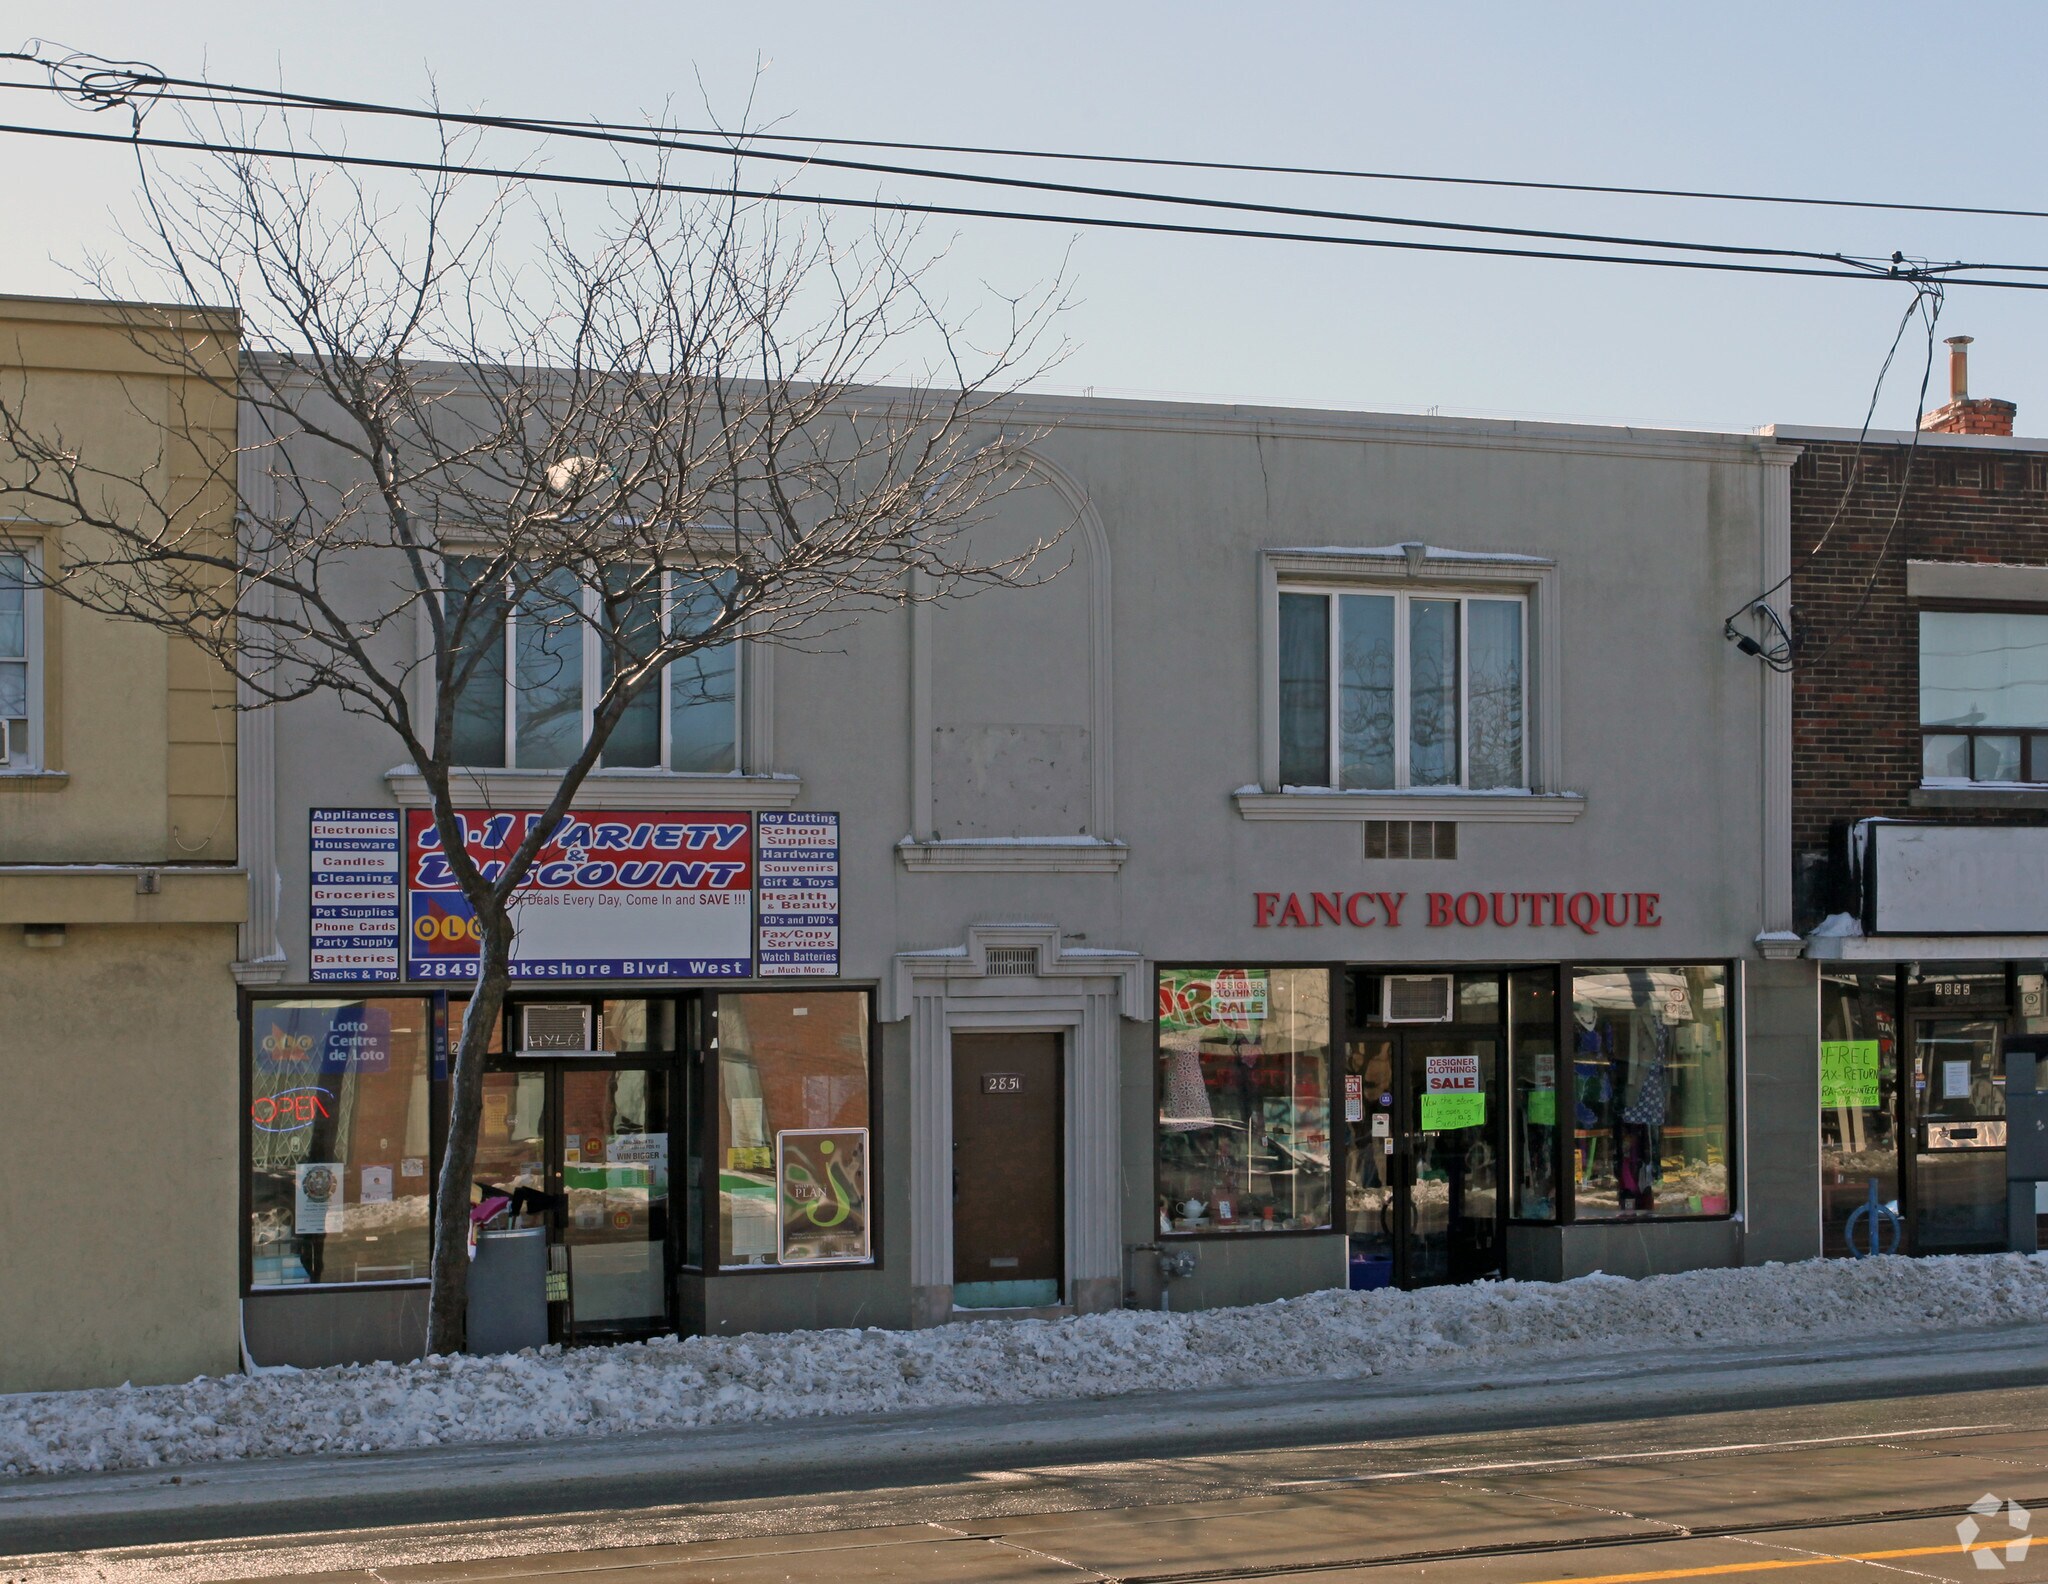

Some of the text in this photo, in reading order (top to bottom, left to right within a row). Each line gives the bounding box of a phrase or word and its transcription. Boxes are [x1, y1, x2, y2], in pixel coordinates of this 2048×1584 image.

[314, 810, 394, 820] Appliances
[760, 813, 836, 824] Key Cutting
[314, 826, 395, 834] Electronics
[525, 813, 748, 850] VARIETY
[761, 827, 826, 836] School
[315, 840, 395, 849] Houseware
[768, 837, 835, 846] Supplies
[567, 849, 586, 863] &
[762, 850, 834, 858] Hardware
[323, 858, 384, 866] Candles
[764, 864, 834, 872] Souvenirs
[318, 874, 393, 884] Cleaning
[763, 878, 834, 887] Gift & Toys
[315, 891, 395, 899] Groceries
[762, 892, 826, 900] Health
[528, 894, 559, 905] Deals
[563, 894, 594, 906] Every
[599, 894, 622, 907] Day,
[626, 894, 657, 905] Come
[662, 894, 671, 905] In
[676, 894, 695, 905] and
[699, 894, 730, 905] SAVE
[734, 894, 745, 905] !!!
[781, 901, 836, 910] Beauty
[316, 908, 394, 917] Pet Supplies
[1254, 892, 1662, 935] FANCY BOUTIQUE
[764, 916, 833, 924] CD's and DVD's
[315, 923, 396, 931] Phone Cards
[762, 930, 831, 939] Fax/Copy
[316, 938, 393, 948] Party Supply
[768, 939, 835, 948] Services
[761, 952, 836, 961] Watch Batteries
[420, 962, 742, 976] 2849 akeshore Blvd. West
[314, 970, 396, 980] Snacks & Pop
[1935, 984, 1970, 994] 2855
[1216, 1002, 1263, 1013] SALE
[330, 1021, 368, 1031] Lotto
[265, 1037, 310, 1049] OLG
[329, 1035, 377, 1046] Centre
[329, 1049, 384, 1060] de Loto
[1430, 1058, 1474, 1066] DESIGNER
[1428, 1066, 1477, 1074] CLOTHINGS
[989, 1077, 1019, 1090] 2851
[1347, 1083, 1358, 1092] EN
[1431, 1078, 1474, 1089] SALE
[252, 1096, 330, 1122] OPEN
[633, 1152, 659, 1160] BIGGER
[795, 1188, 828, 1198] PLAN
